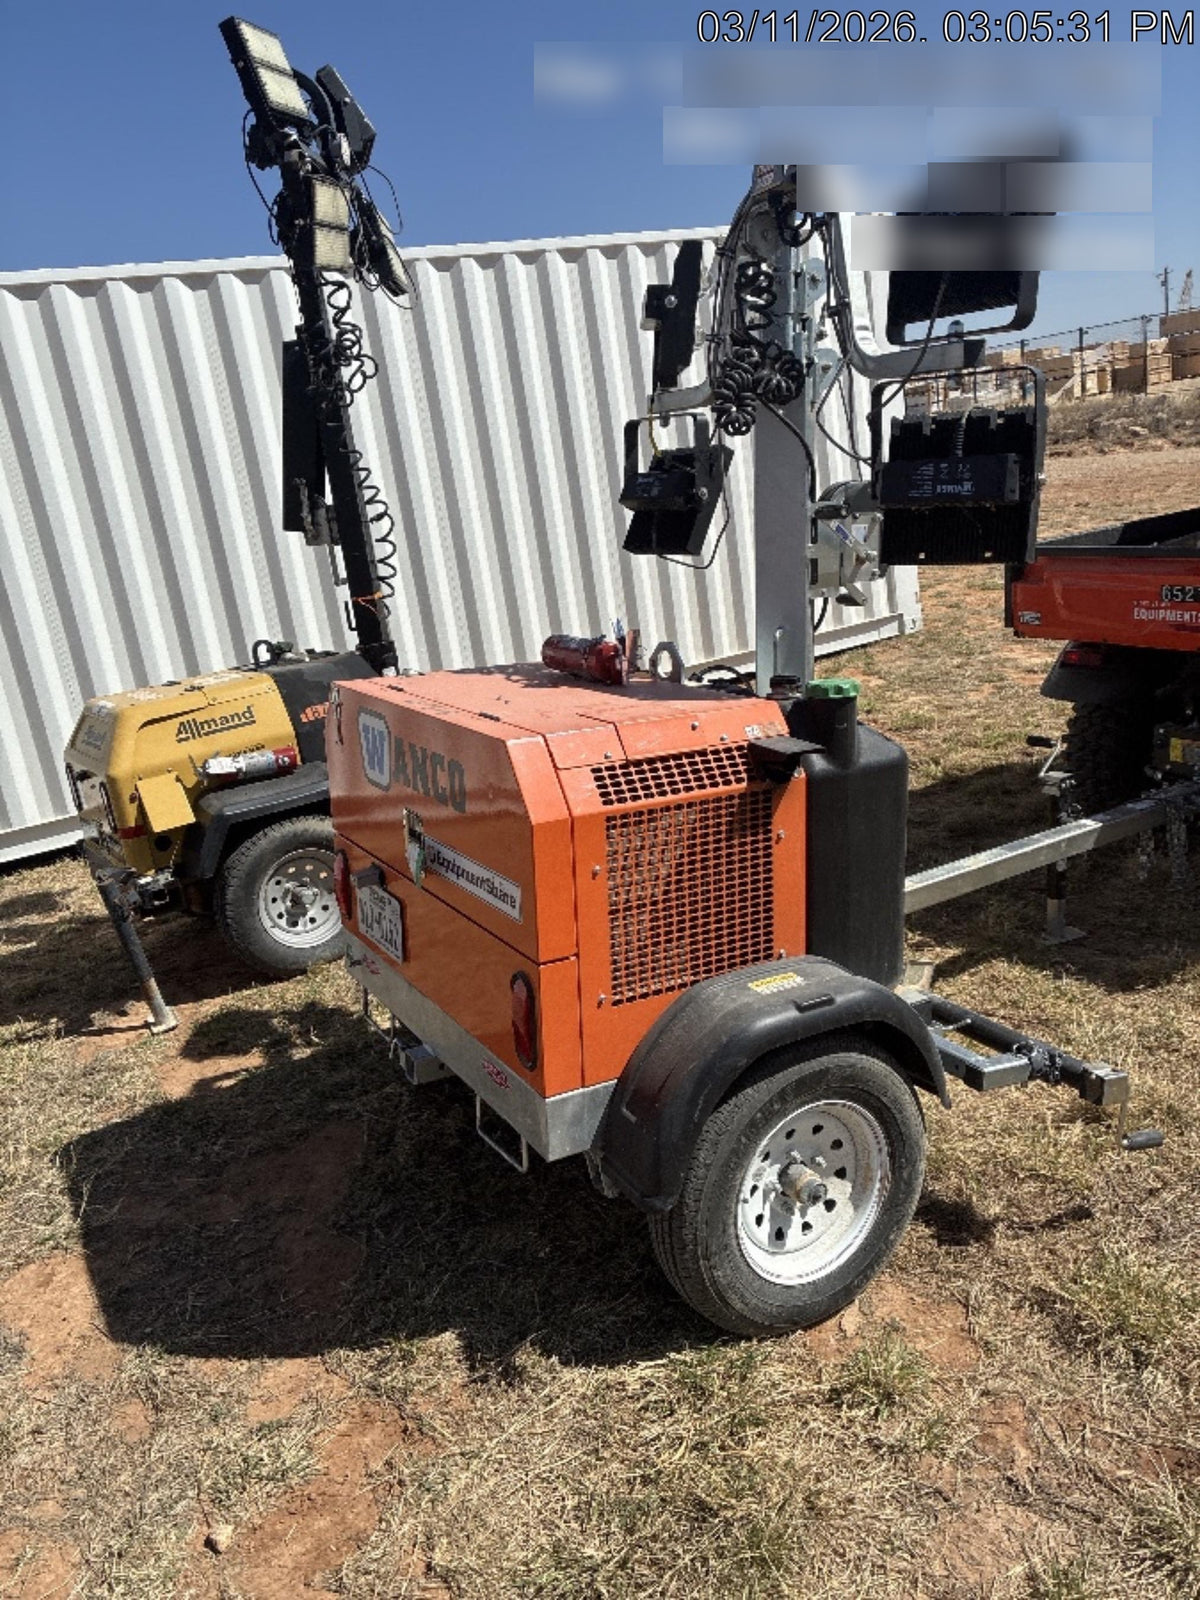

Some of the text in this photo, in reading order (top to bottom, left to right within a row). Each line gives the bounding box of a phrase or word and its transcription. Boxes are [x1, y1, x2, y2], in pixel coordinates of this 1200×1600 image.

[1162, 585, 1200, 602] 652
[175, 704, 256, 741] Allmand
[361, 722, 467, 813] WANCO
